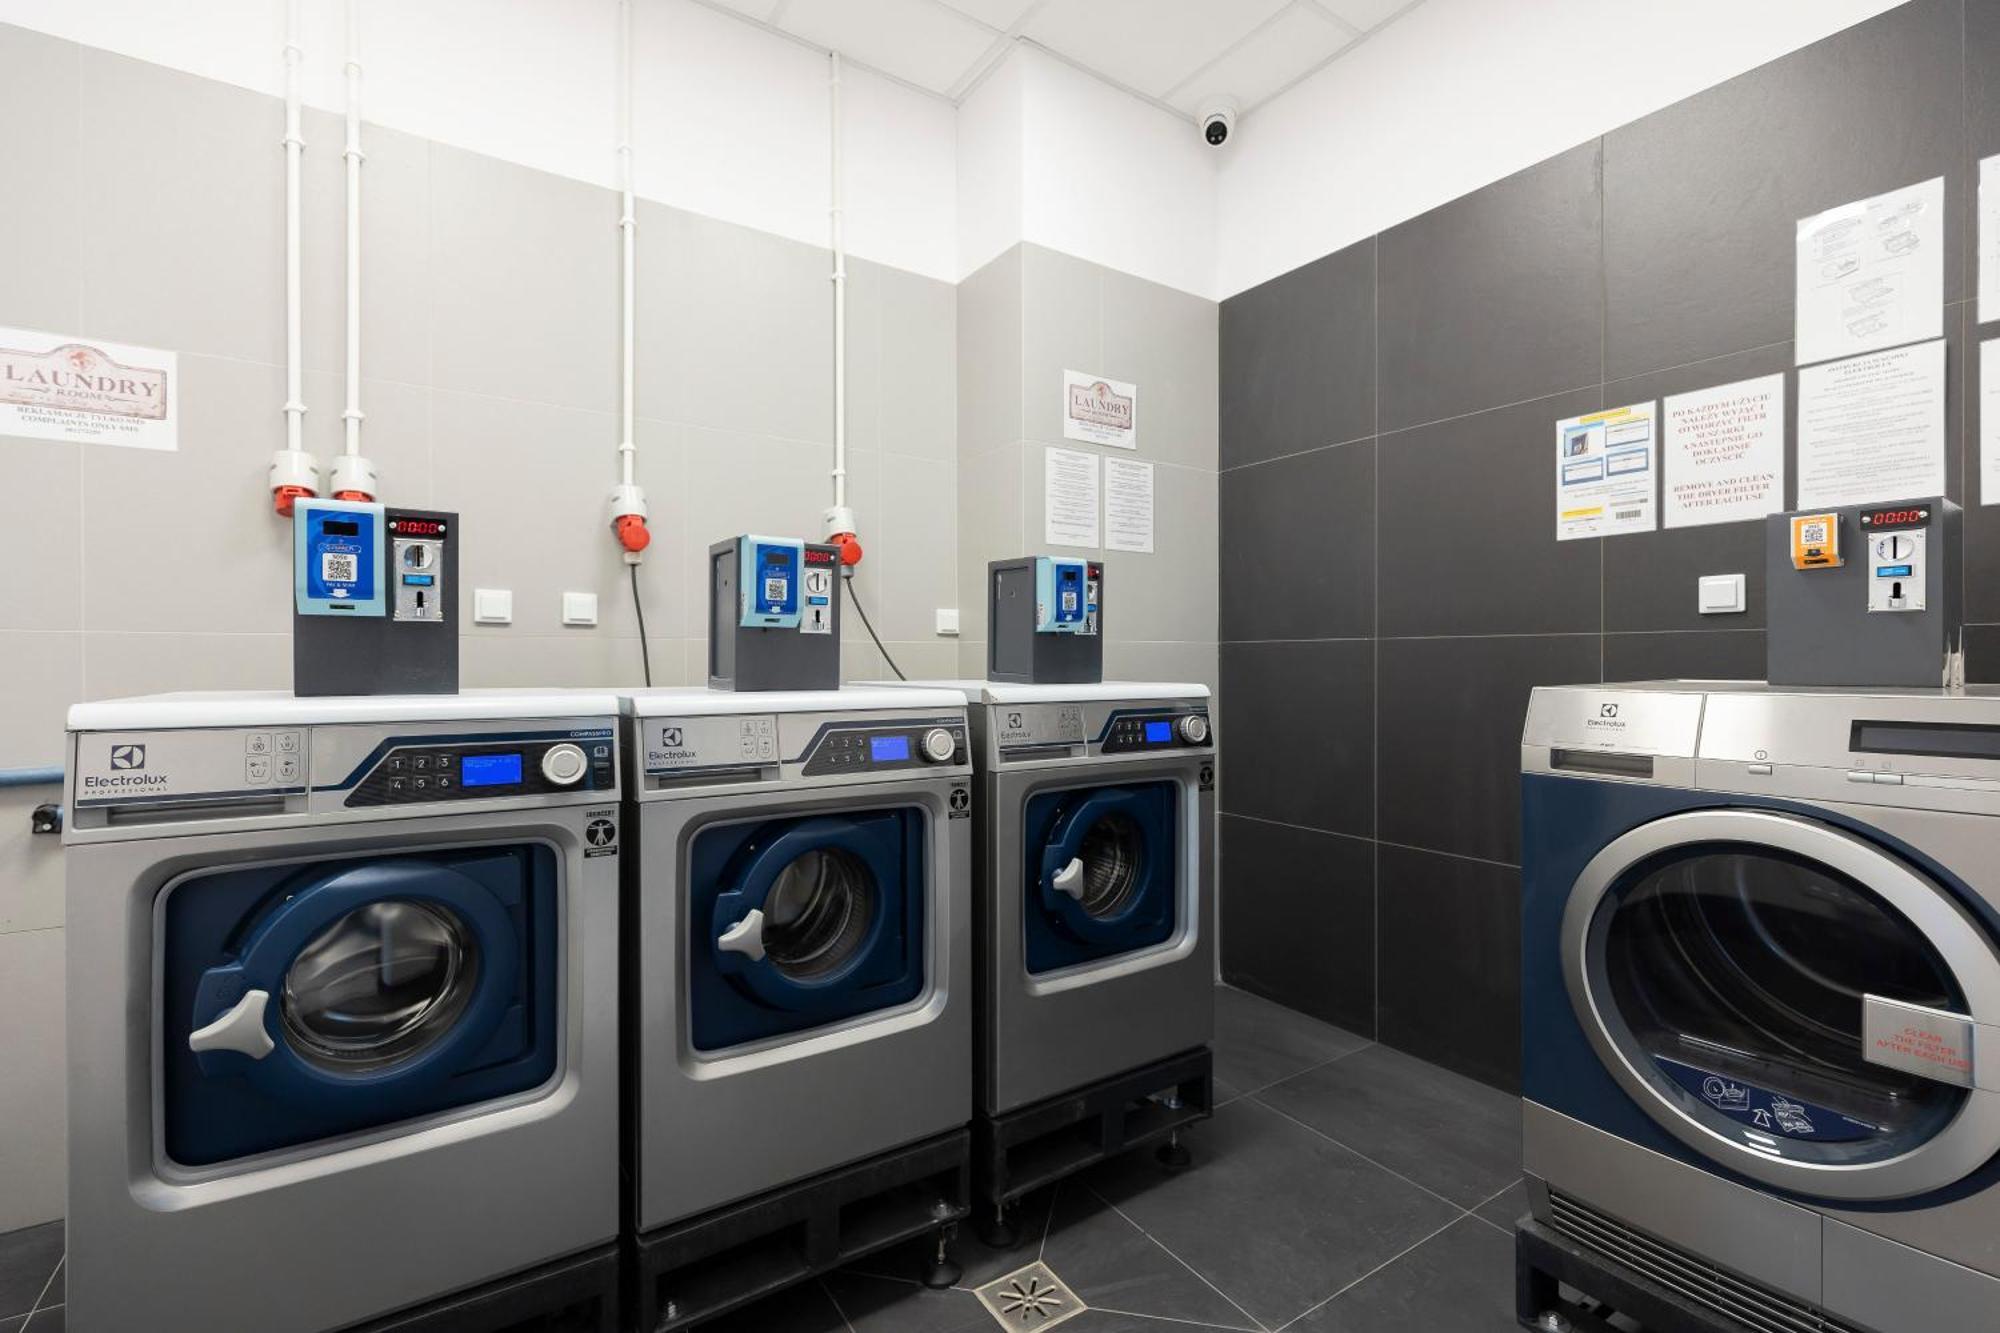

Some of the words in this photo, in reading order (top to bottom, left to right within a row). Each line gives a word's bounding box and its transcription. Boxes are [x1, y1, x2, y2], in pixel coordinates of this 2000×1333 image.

[6, 364, 158, 397] LAUNDRY
[1075, 394, 1129, 415] LAUNDRY
[1674, 481, 1713, 493] REMOVE
[1717, 478, 1737, 486] AND
[1739, 473, 1776, 484] CLEAN
[1677, 493, 1695, 501] THE
[1698, 487, 1732, 498] DRYER
[1734, 483, 1770, 493] FILTER
[1682, 498, 1713, 509] AFTER
[1715, 495, 1743, 505] EACH
[1746, 492, 1763, 501] USE
[1587, 719, 1626, 728] Electrolux
[418, 759, 425, 768] 2
[441, 758, 448, 767] 3
[649, 751, 697, 760] Electrolux
[84, 774, 168, 788] Electrolux
[394, 781, 401, 789] 4
[418, 780, 425, 788] 5
[441, 778, 448, 787] 6
[84, 785, 168, 796] PROFESSIONAL
[1904, 1027, 1942, 1043] CLEAN
[1876, 1038, 1911, 1053] AFTER
